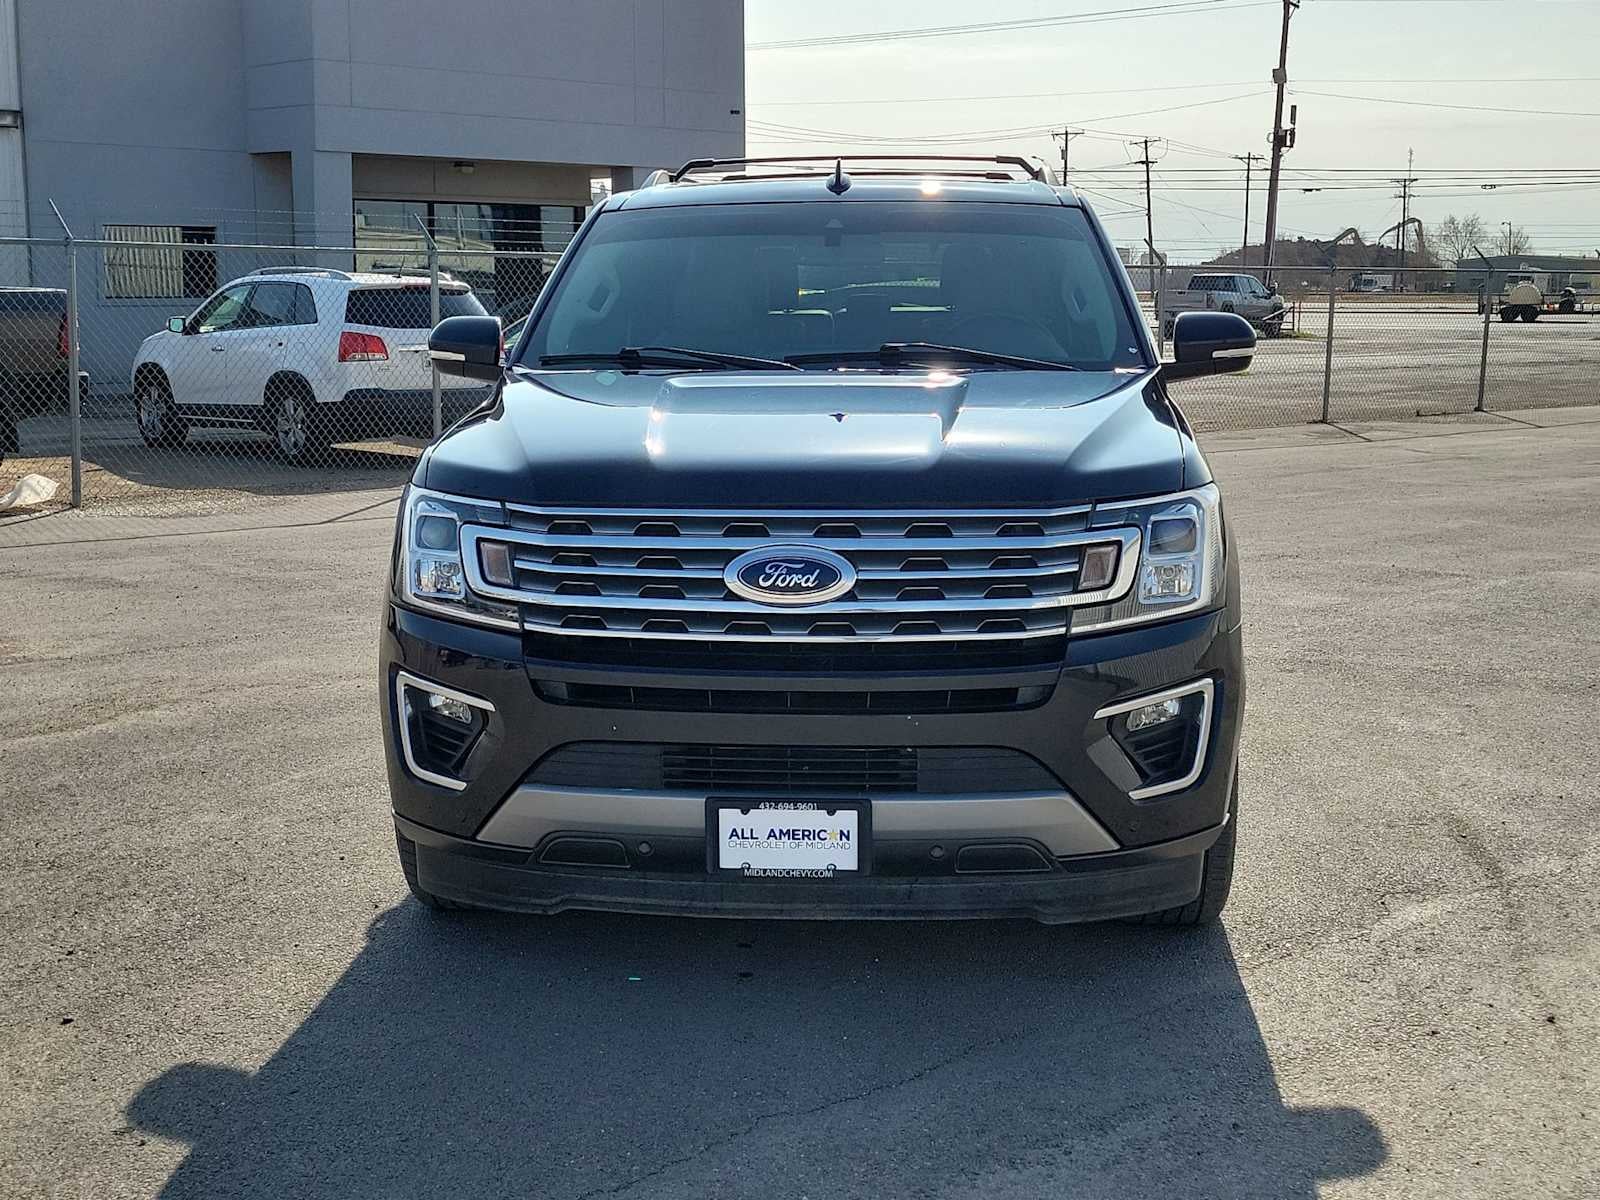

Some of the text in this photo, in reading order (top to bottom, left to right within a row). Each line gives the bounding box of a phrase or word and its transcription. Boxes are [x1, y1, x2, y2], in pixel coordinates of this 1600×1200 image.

[758, 562, 820, 587] Ford
[759, 802, 818, 811] 432-694-9601
[728, 828, 759, 840] ALL
[728, 840, 851, 850] CHEVROLET OF MIDLAND
[744, 868, 834, 878] MIDLANDCHEVY.COM
